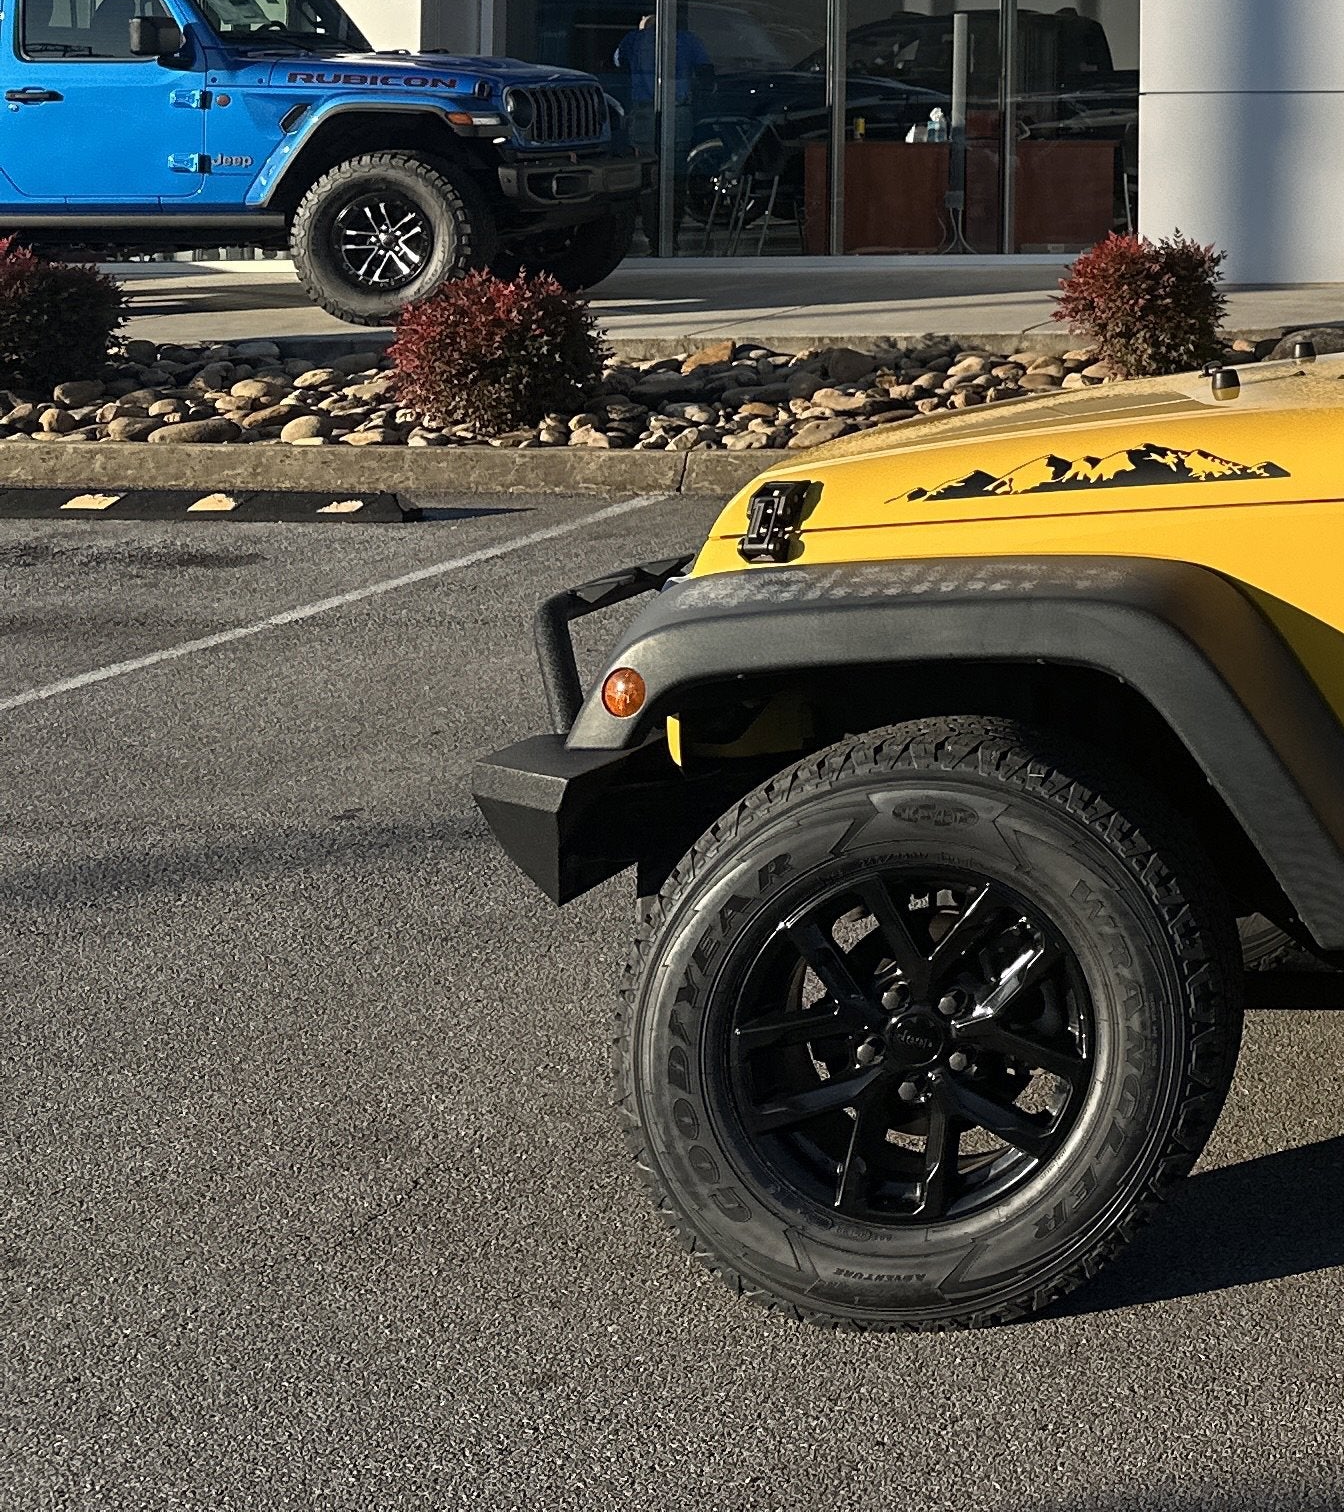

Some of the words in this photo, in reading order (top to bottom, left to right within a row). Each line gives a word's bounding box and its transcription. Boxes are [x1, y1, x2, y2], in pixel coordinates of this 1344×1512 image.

[211, 154, 253, 168] Jeep
[287, 72, 457, 88] RUBICON
[668, 852, 793, 1223] GOODYEAR
[1032, 878, 1147, 1240] WRANGLER
